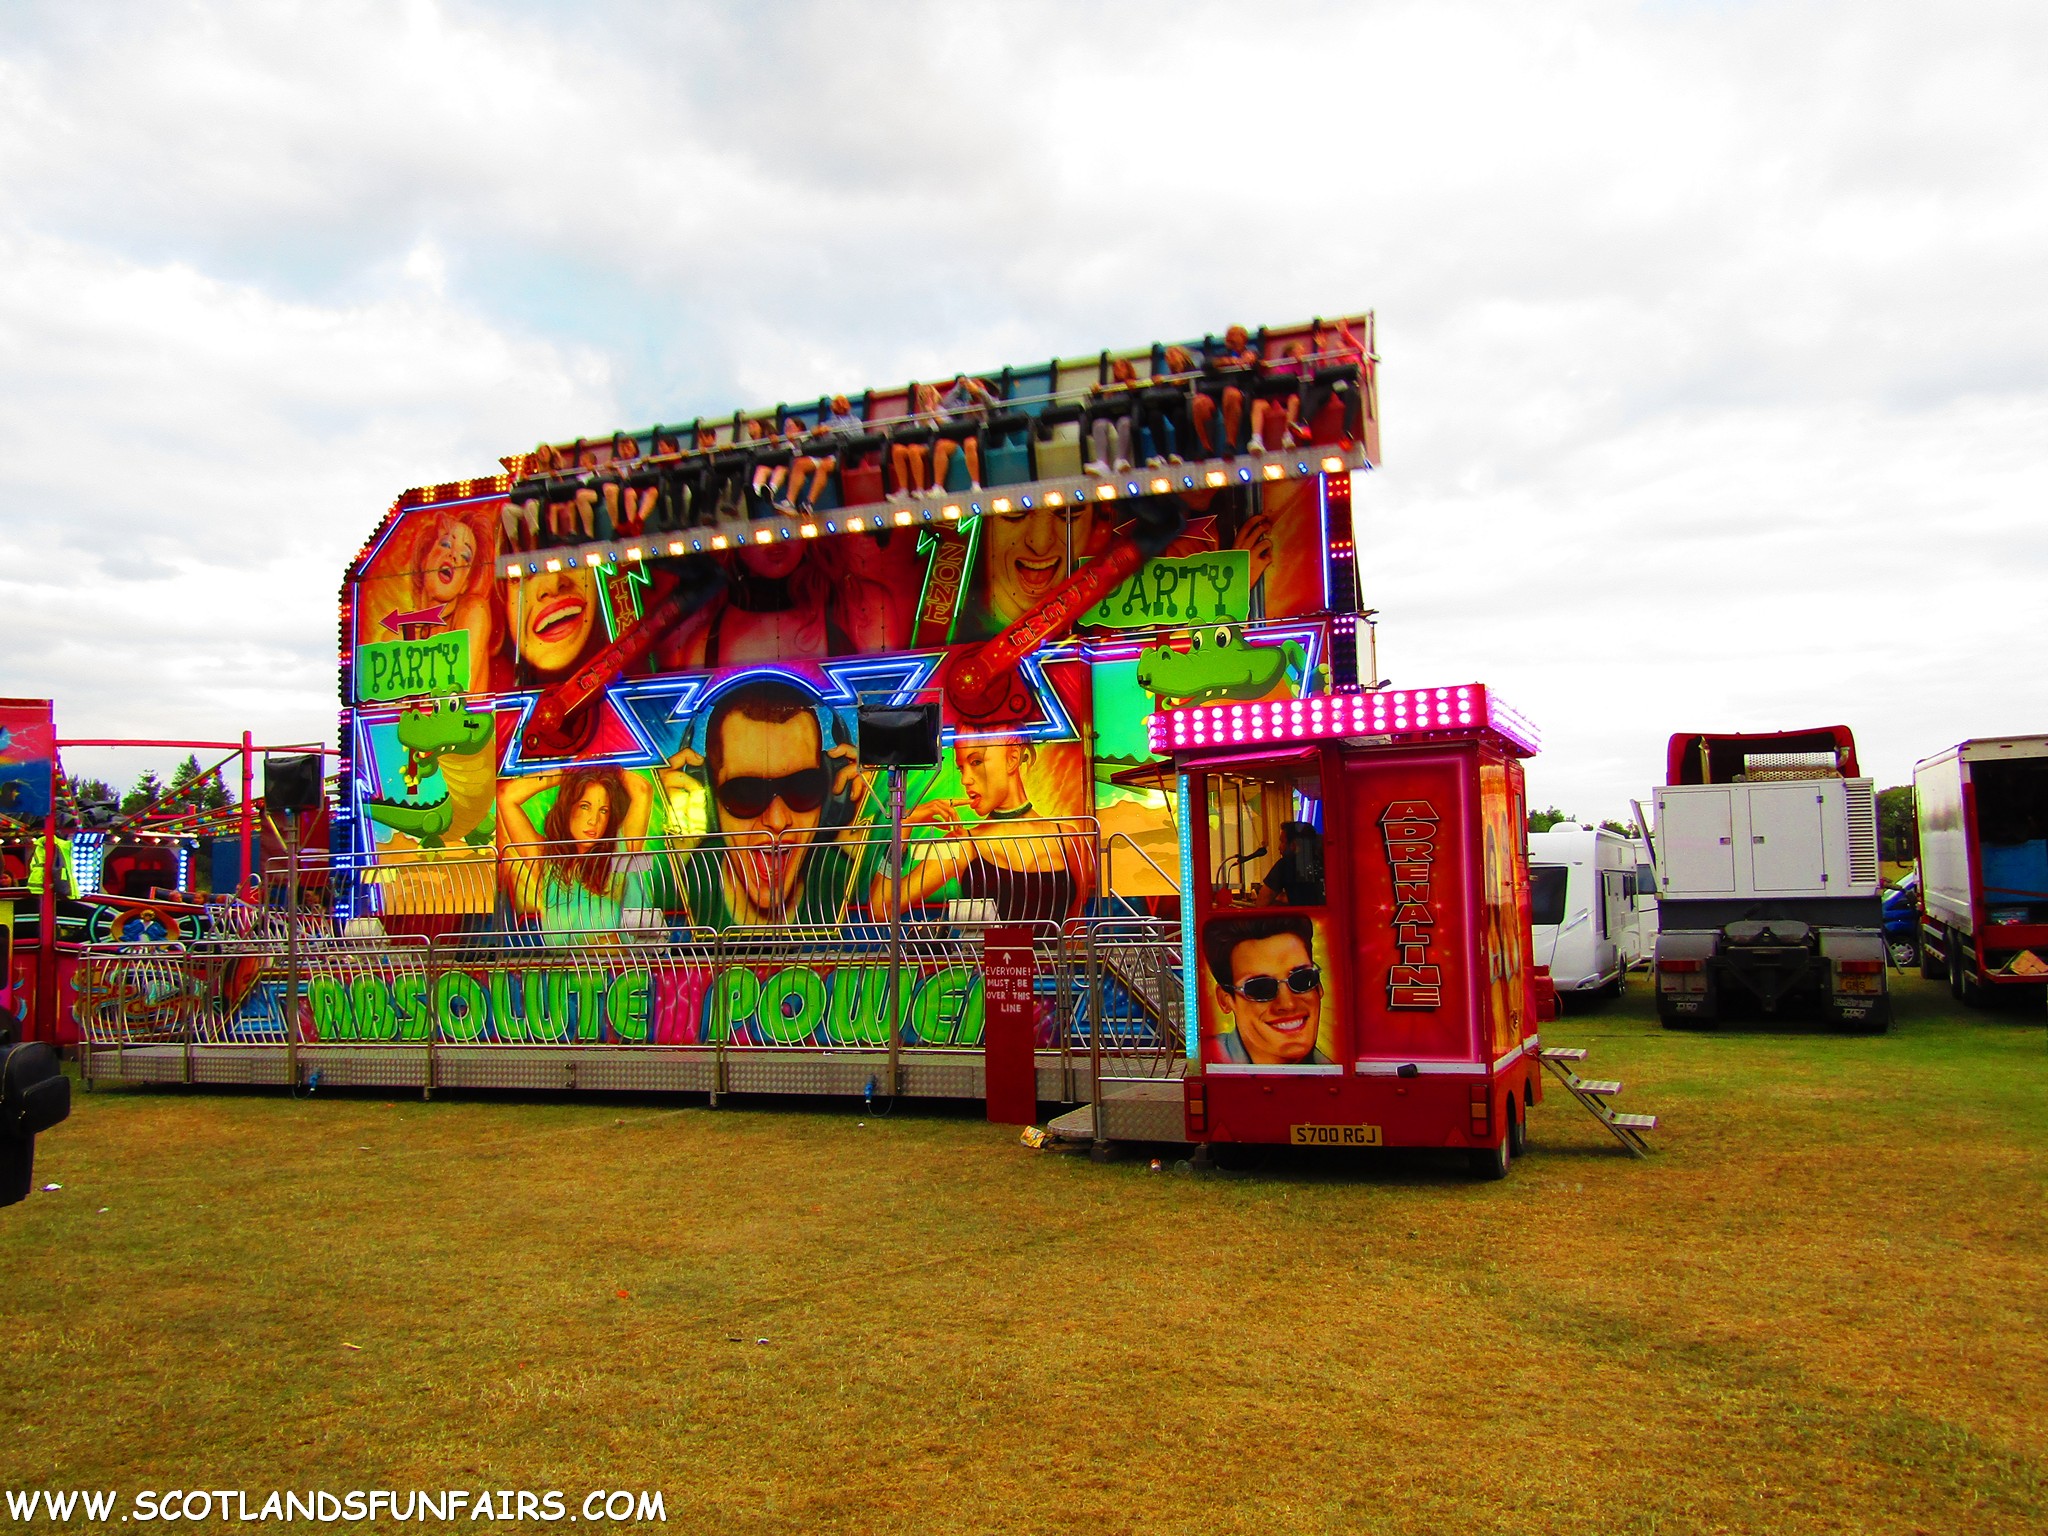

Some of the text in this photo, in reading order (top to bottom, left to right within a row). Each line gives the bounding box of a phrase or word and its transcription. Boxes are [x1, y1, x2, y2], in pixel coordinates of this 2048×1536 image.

[924, 542, 966, 625] ZONE
[371, 643, 460, 694] PARTY
[1380, 800, 1441, 1008] ADRENALINE
[985, 966, 1031, 976] EVERYONE!
[987, 979, 1028, 988] MUST BE
[986, 991, 1031, 1001] OVER THIS
[307, 969, 649, 1041] ABSOLUTE
[1000, 1002, 1022, 1013] LINE
[1296, 1127, 1376, 1144] S700 RGJ
